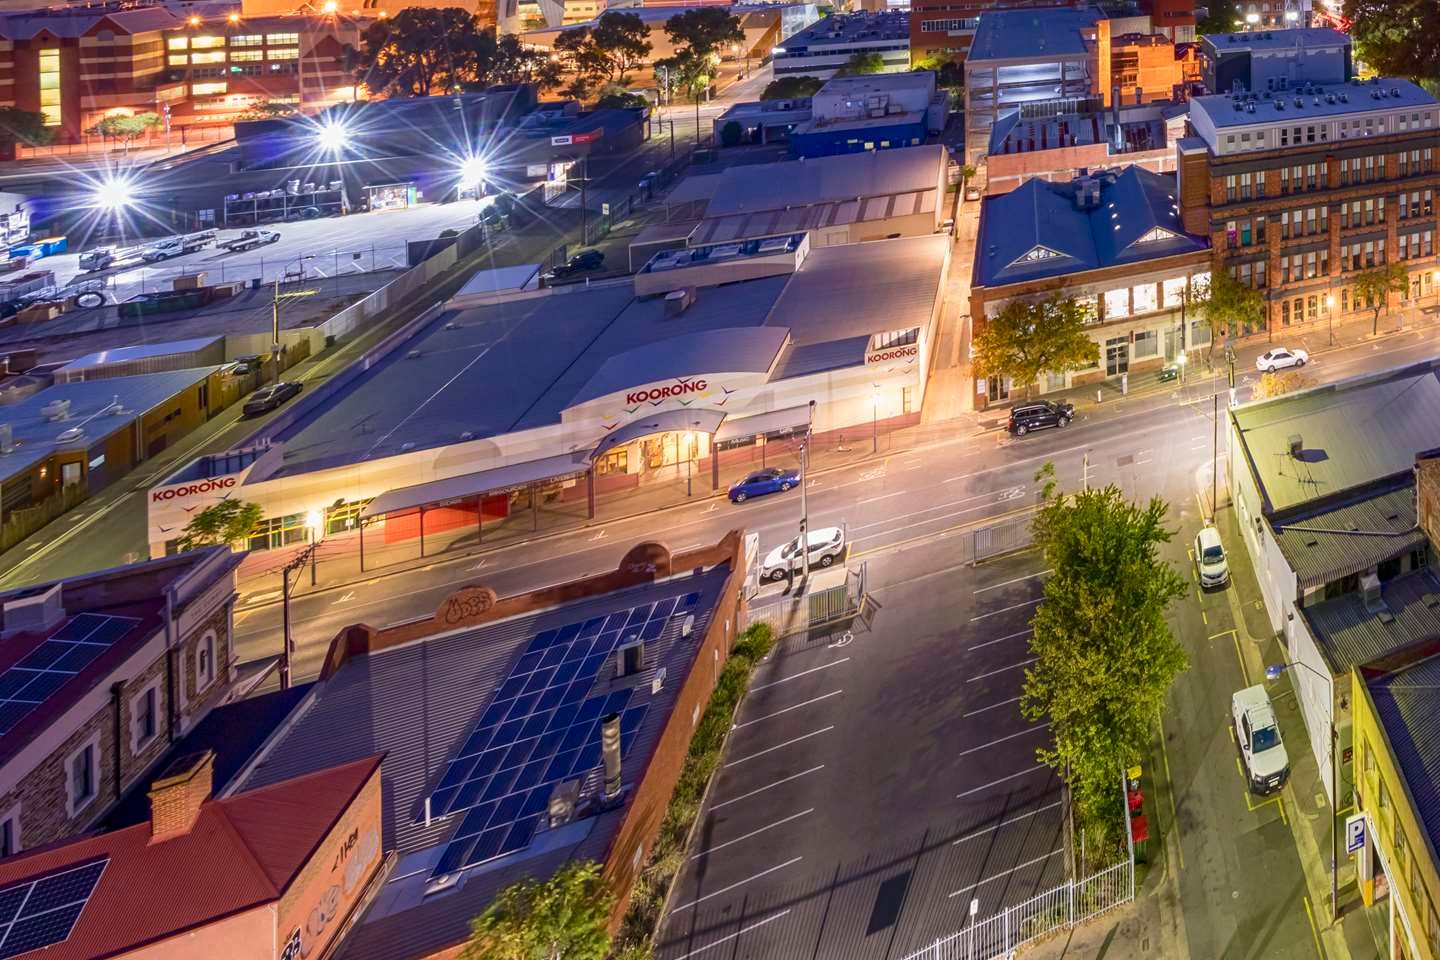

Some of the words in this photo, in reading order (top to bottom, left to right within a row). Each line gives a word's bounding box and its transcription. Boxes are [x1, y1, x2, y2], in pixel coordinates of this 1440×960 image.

[867, 347, 917, 363] KOORONG
[626, 380, 707, 404] KOORONG
[152, 478, 236, 502] KOORONG
[1349, 820, 1363, 846] P
